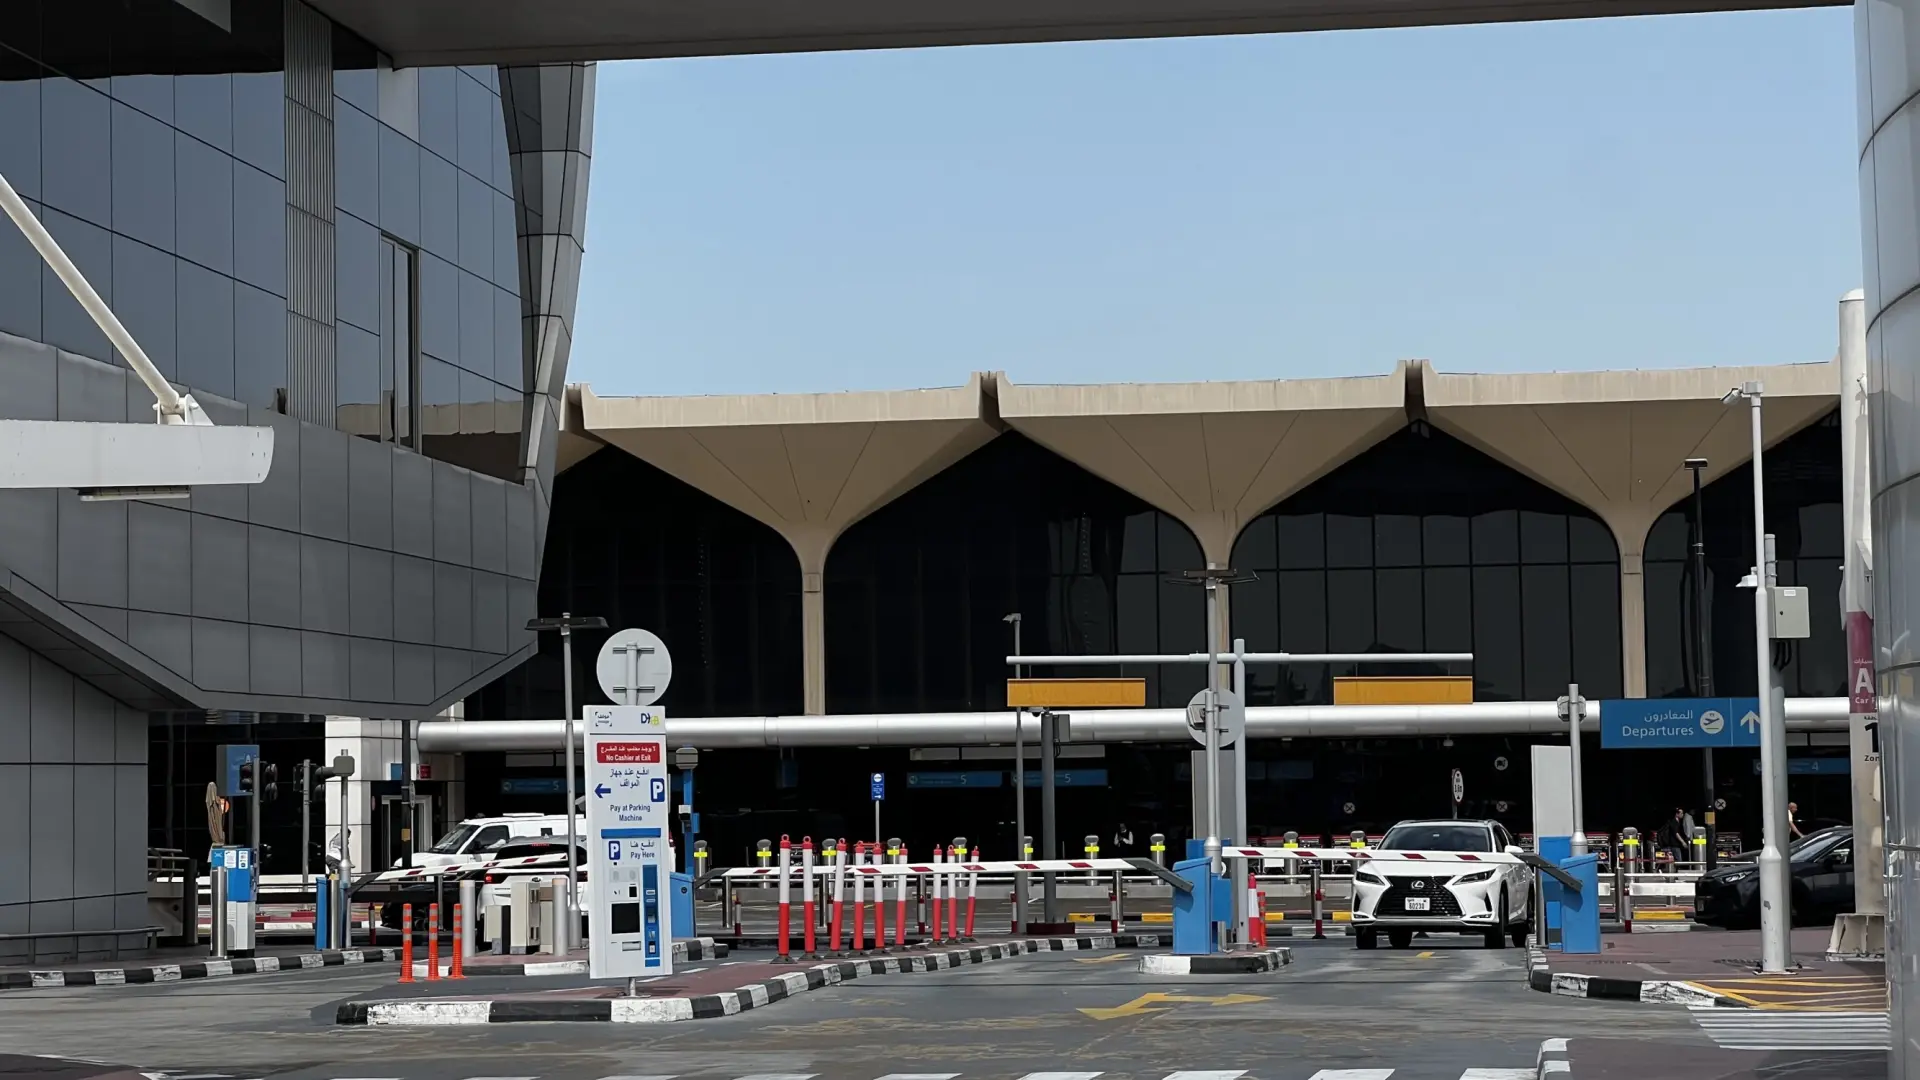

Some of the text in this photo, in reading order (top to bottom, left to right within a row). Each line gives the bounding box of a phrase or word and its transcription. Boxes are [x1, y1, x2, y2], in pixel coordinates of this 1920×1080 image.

[1856, 668, 1874, 694] A
[1643, 710, 1693, 723] المغادرون
[1622, 725, 1694, 739] Departures
[1812, 760, 1818, 771] 4
[609, 768, 623, 778] جهاز
[624, 768, 634, 776] عند
[960, 774, 967, 785] 5
[1064, 774, 1070, 782] 5
[552, 780, 560, 790] 5
[652, 781, 664, 800] P
[610, 804, 621, 813] Pay
[628, 804, 651, 813] Parking
[619, 814, 642, 822] Machine
[610, 842, 620, 858] P
[630, 851, 641, 859] Pay
